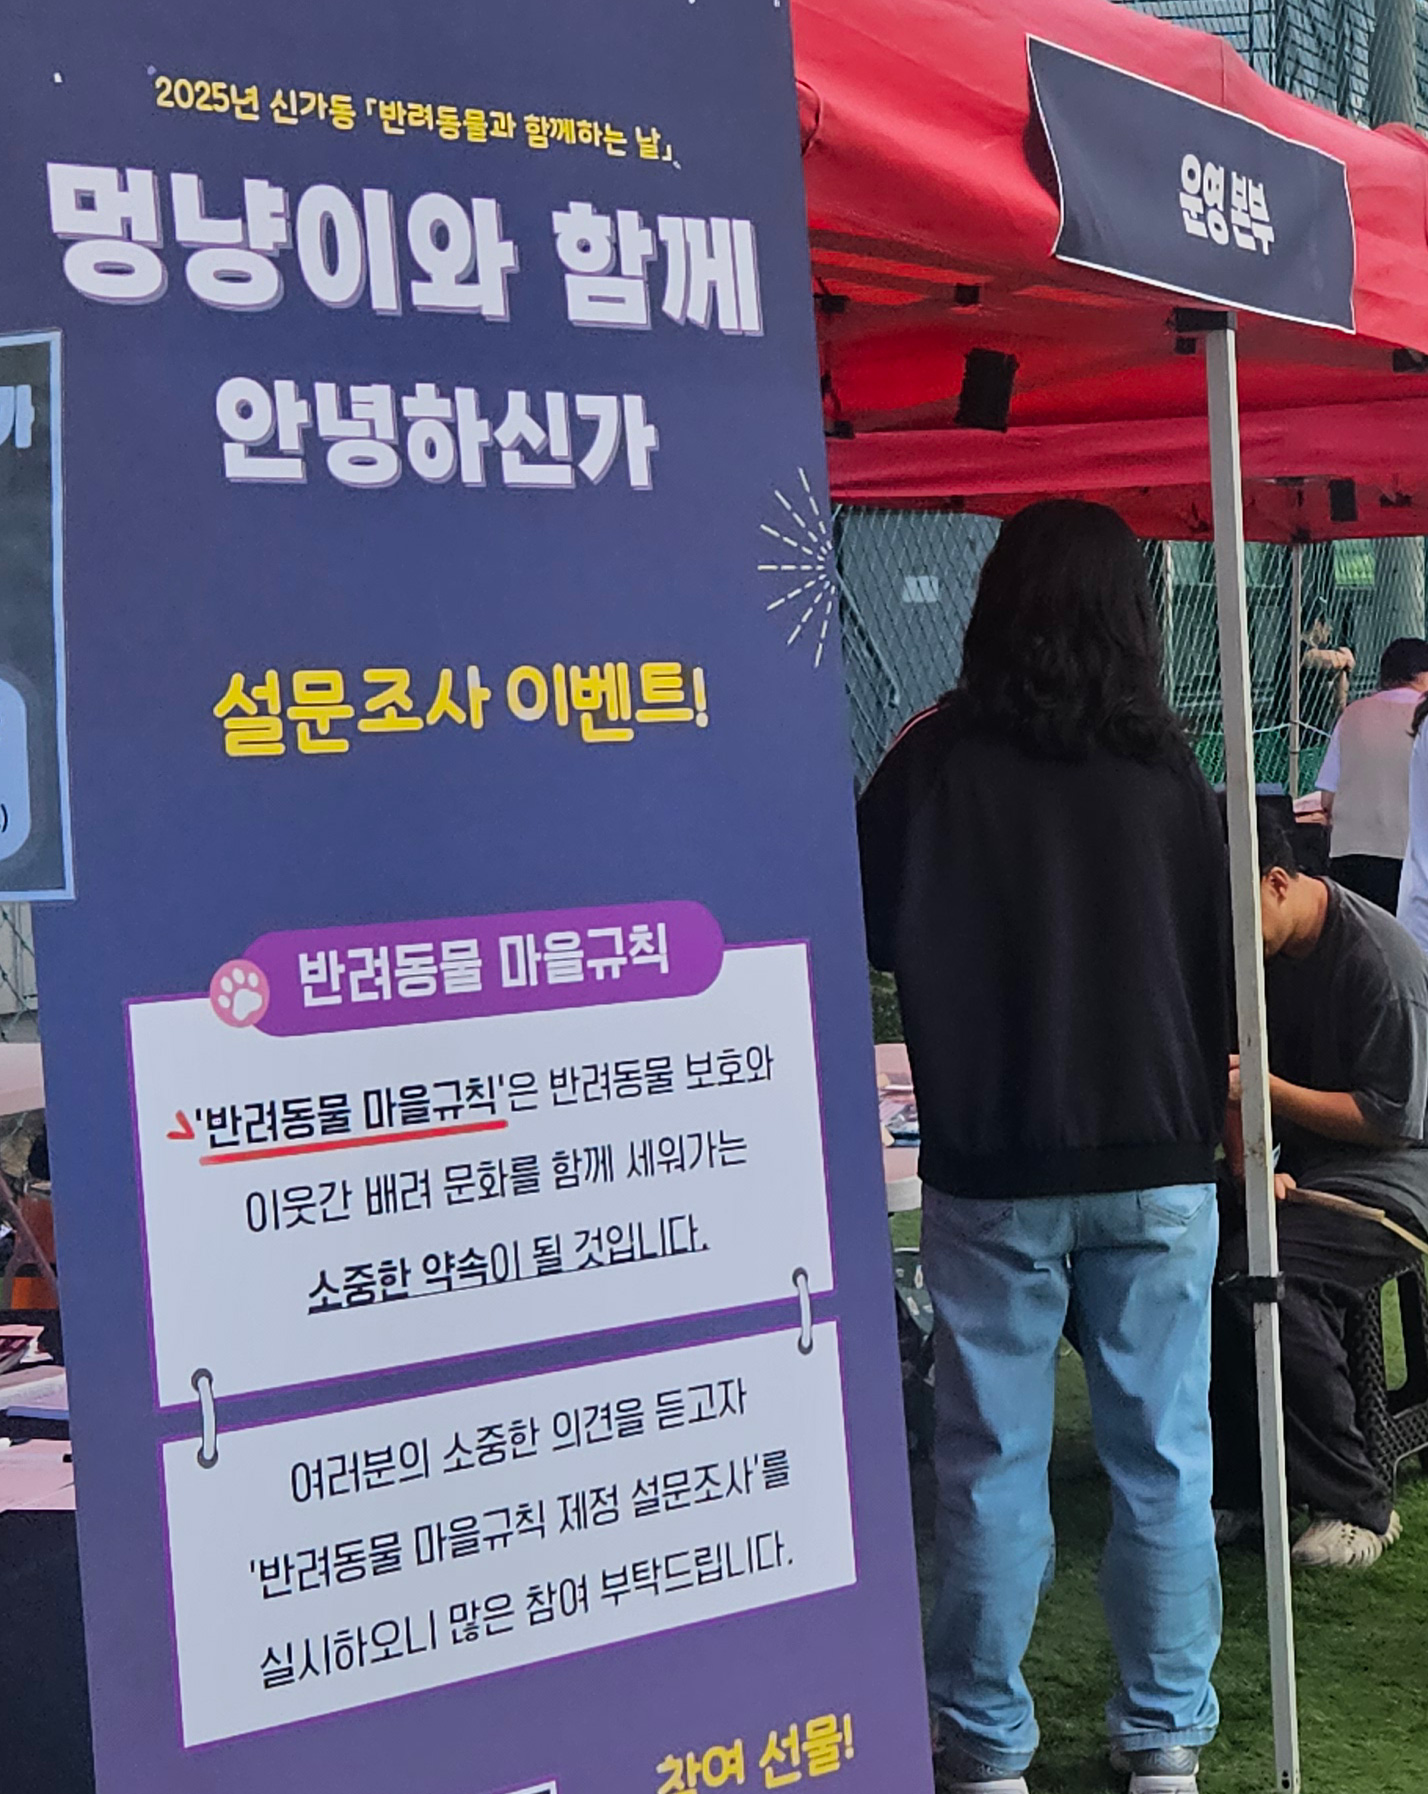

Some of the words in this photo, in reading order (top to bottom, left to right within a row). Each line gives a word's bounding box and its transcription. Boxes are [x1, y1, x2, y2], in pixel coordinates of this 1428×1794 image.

[154, 75, 260, 123] 2025년
[269, 87, 356, 131] 신가동
[524, 111, 628, 158] 함께하는
[46, 161, 520, 321] 멍냥이와
[552, 200, 765, 337] 함께
[215, 376, 660, 490] 안녕하신가
[212, 664, 492, 758] 설문조사
[504, 659, 711, 744] 이벤트!
[298, 939, 484, 1008] 반려동물
[498, 921, 672, 990] 마을규칙
[195, 1093, 352, 1149] '반려동물
[363, 1071, 539, 1129] 마을규칙'은
[549, 1056, 674, 1106] 반려동물
[686, 1043, 775, 1088] 보호와
[246, 1178, 353, 1233] 이웃간
[366, 1168, 431, 1217] 배려
[443, 1154, 541, 1207] 문화를
[551, 1143, 614, 1190] 함께
[626, 1128, 748, 1180] 세워가는
[308, 1256, 411, 1311] 소중한
[422, 1240, 521, 1288] 약속이
[532, 1233, 564, 1276] 될
[573, 1213, 711, 1271] 것입니다.
[290, 1437, 430, 1502] 여러분의
[443, 1416, 541, 1475] 소중한
[551, 1397, 646, 1452] 의견을
[655, 1377, 748, 1430] 듣고자
[249, 1530, 403, 1601] '반려동물
[414, 1500, 546, 1567] 마을규칙
[557, 1483, 620, 1535] 제정
[632, 1448, 792, 1519] 설문조사'를
[260, 1610, 438, 1690] 실시하오니
[449, 1593, 515, 1646] 많은
[525, 1574, 590, 1626] 참여
[600, 1530, 795, 1607] 부탁드립니다.
[758, 1712, 855, 1789] 선물!
